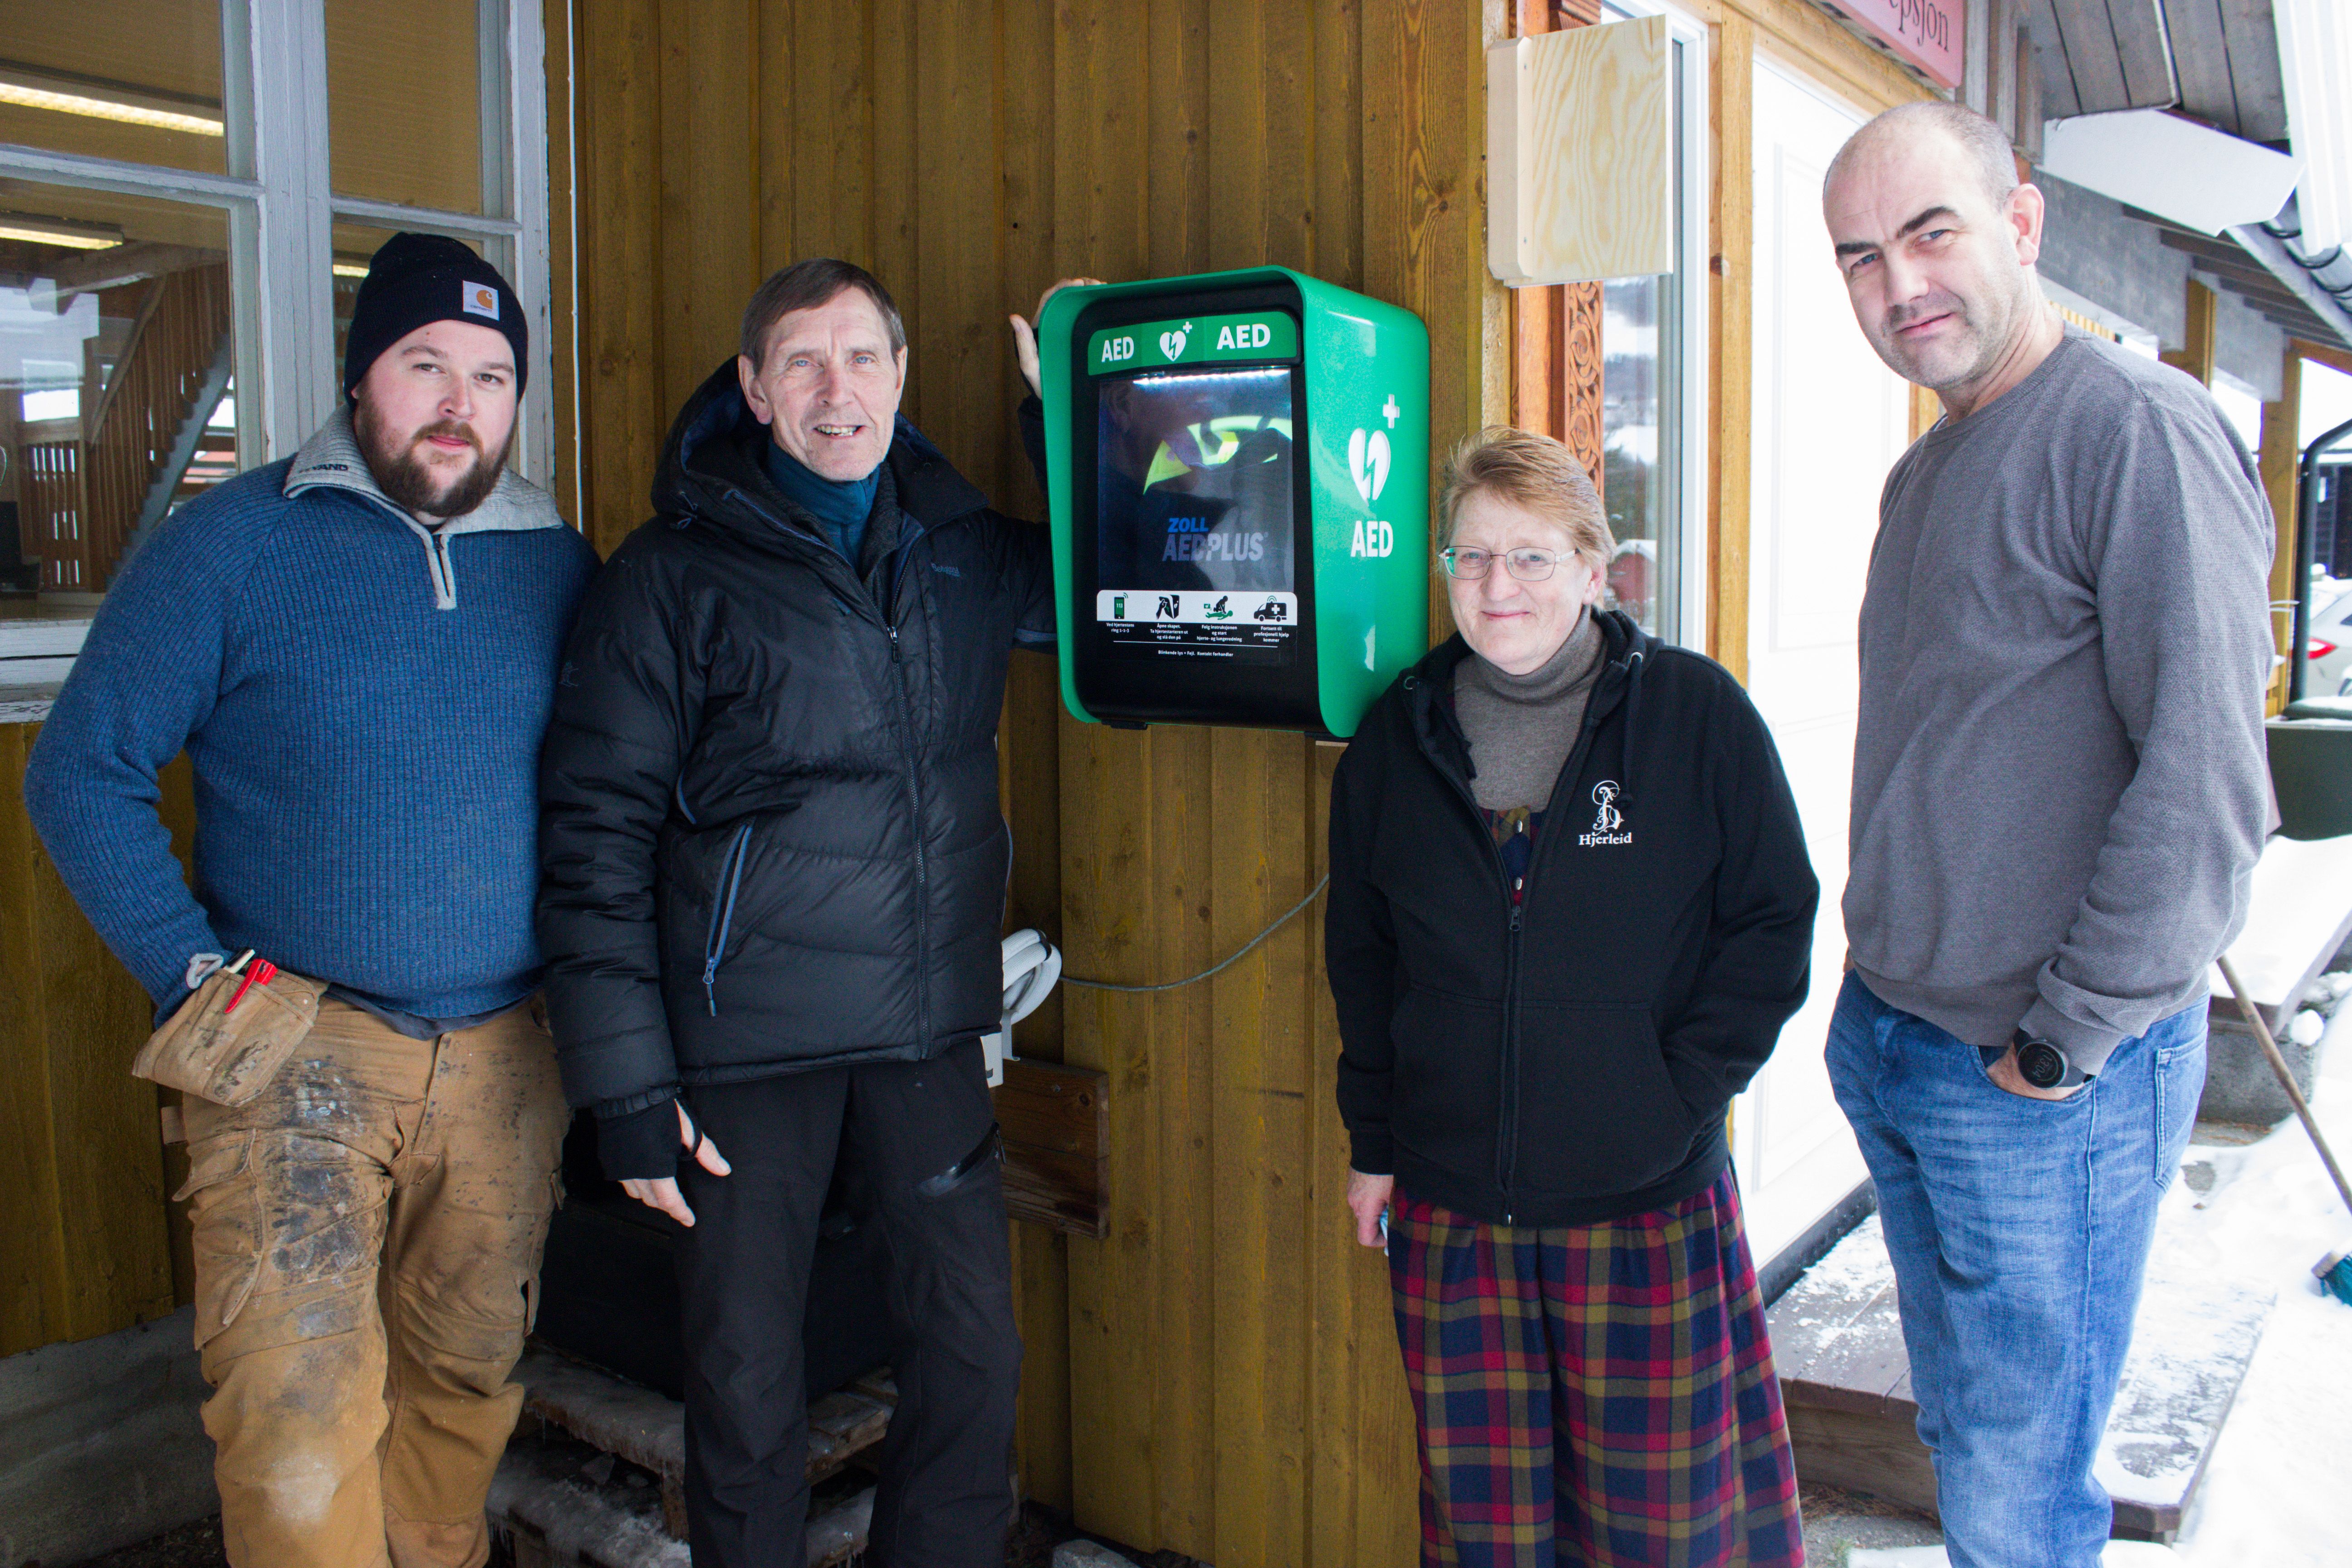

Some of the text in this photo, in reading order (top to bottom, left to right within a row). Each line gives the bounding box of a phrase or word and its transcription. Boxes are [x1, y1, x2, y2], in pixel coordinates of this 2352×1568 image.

[1101, 336, 1135, 362] AED
[1216, 323, 1271, 350] AED
[1167, 517, 1209, 533] ZOLL
[1350, 520, 1393, 558] AED
[1578, 832, 1632, 848] Hjerleid
